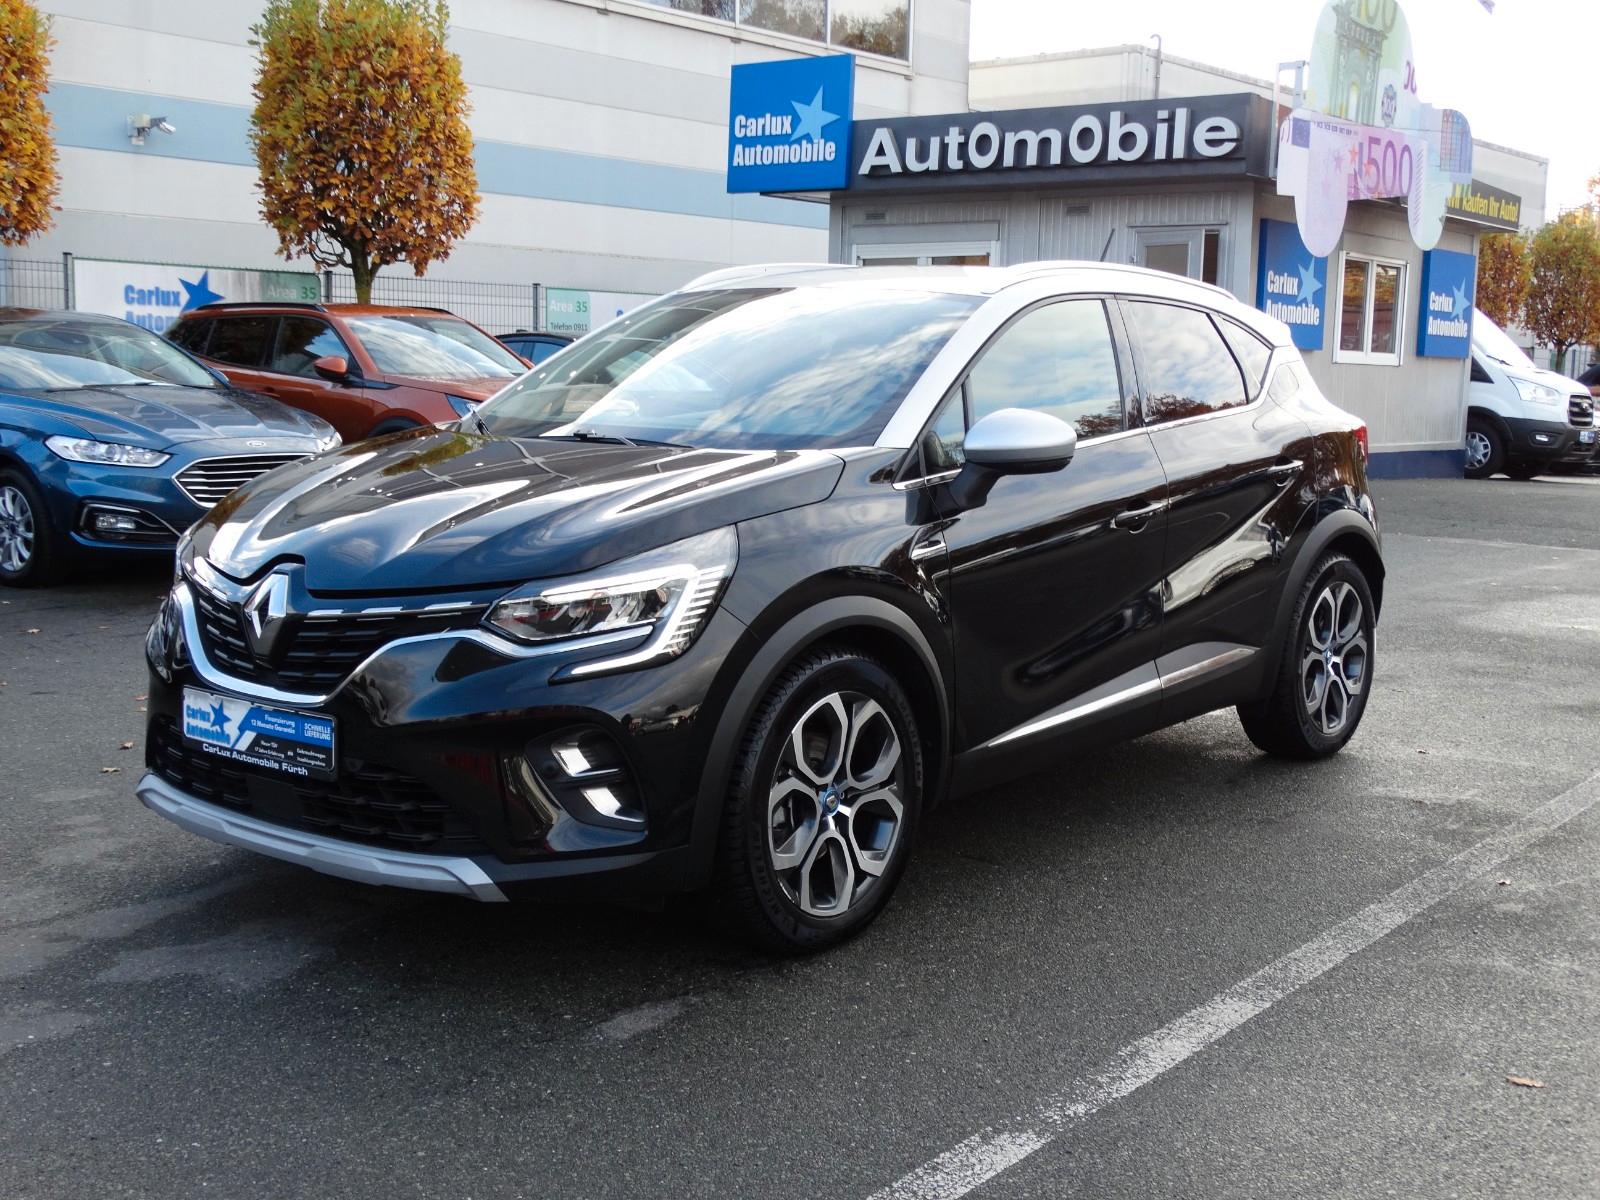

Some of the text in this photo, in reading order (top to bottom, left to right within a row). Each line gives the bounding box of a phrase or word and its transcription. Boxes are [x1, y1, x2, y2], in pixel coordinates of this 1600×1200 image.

[734, 112, 793, 138] Carlux
[733, 138, 836, 167] Automobile
[301, 286, 318, 300] 35
[1267, 270, 1299, 296] Carlux
[124, 284, 182, 307] Carlux
[1429, 291, 1453, 312] Carlux
[575, 301, 588, 313] 35
[1265, 299, 1320, 326] Automobile
[1428, 316, 1468, 338] Automobile
[304, 722, 331, 733] SCHNELLE
[304, 730, 331, 741] LIEFERUNG
[203, 742, 231, 758] CarLux
[232, 751, 280, 770] Automobile
[282, 761, 308, 776] Fürth
